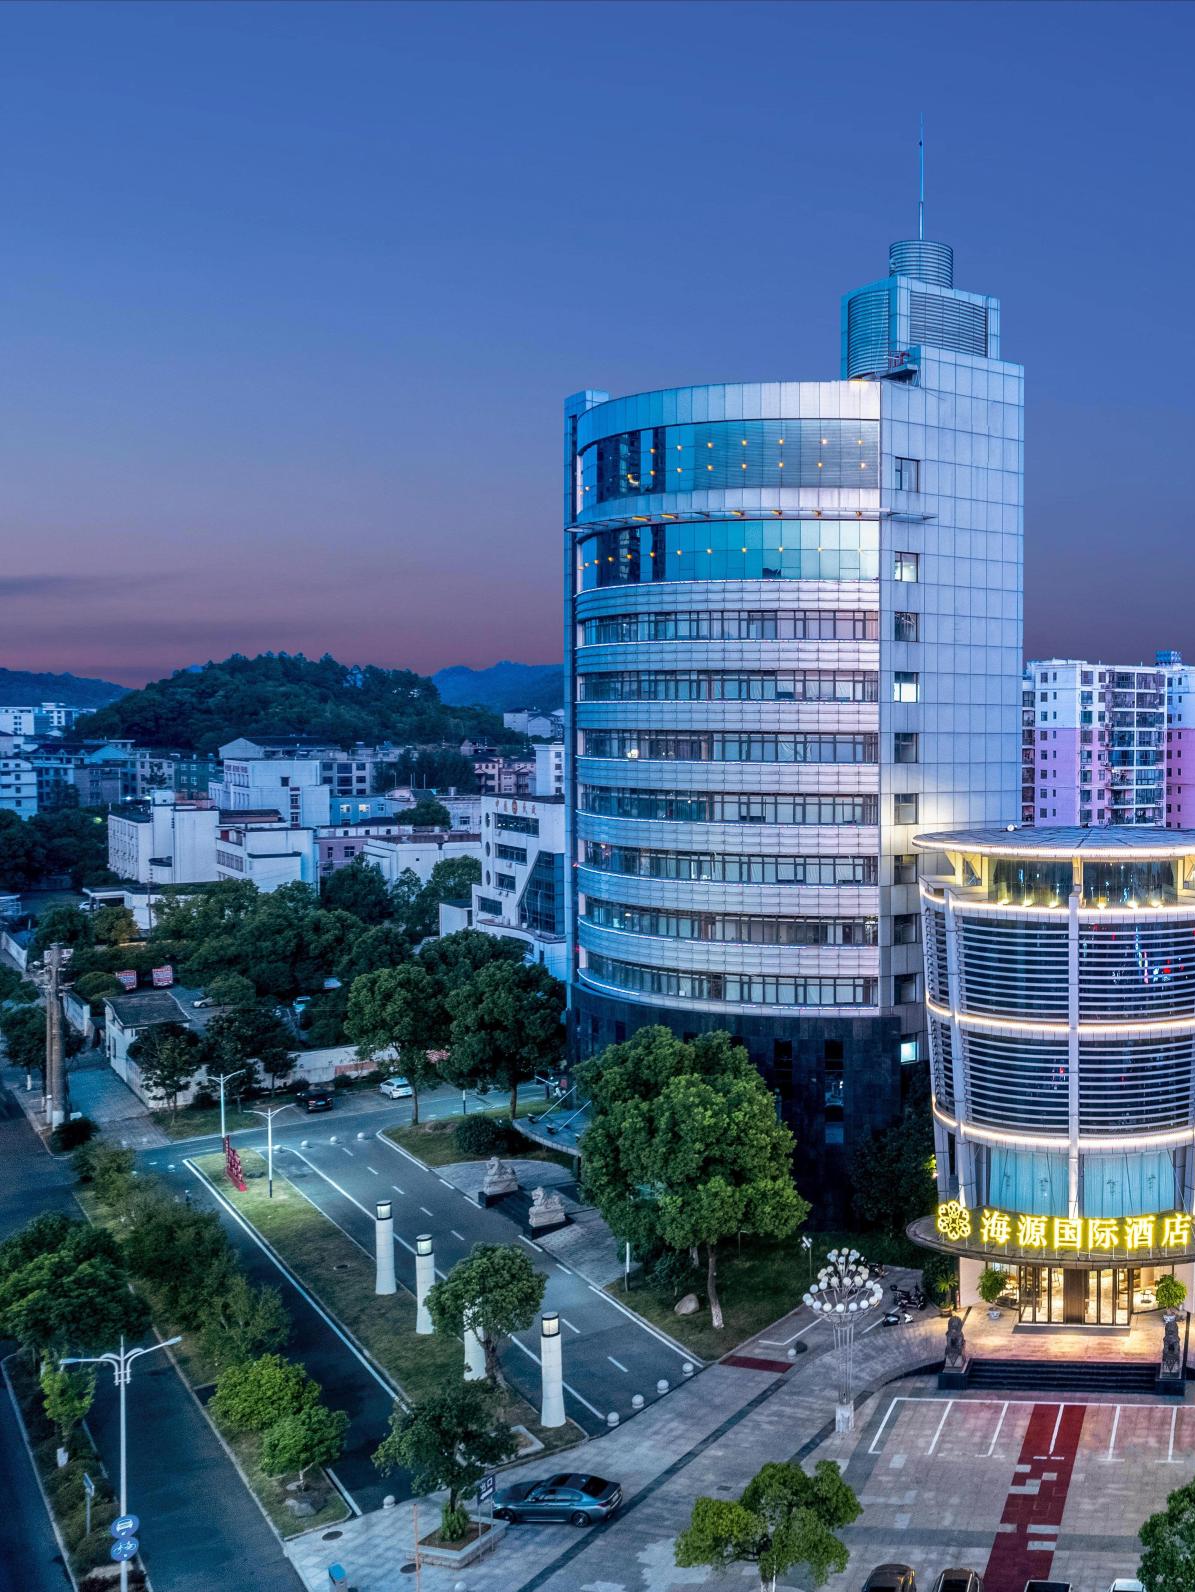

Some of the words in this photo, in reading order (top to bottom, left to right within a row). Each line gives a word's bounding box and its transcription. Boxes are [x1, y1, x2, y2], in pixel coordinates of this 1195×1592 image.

[981, 1209, 1192, 1249] 海源国际酒店
